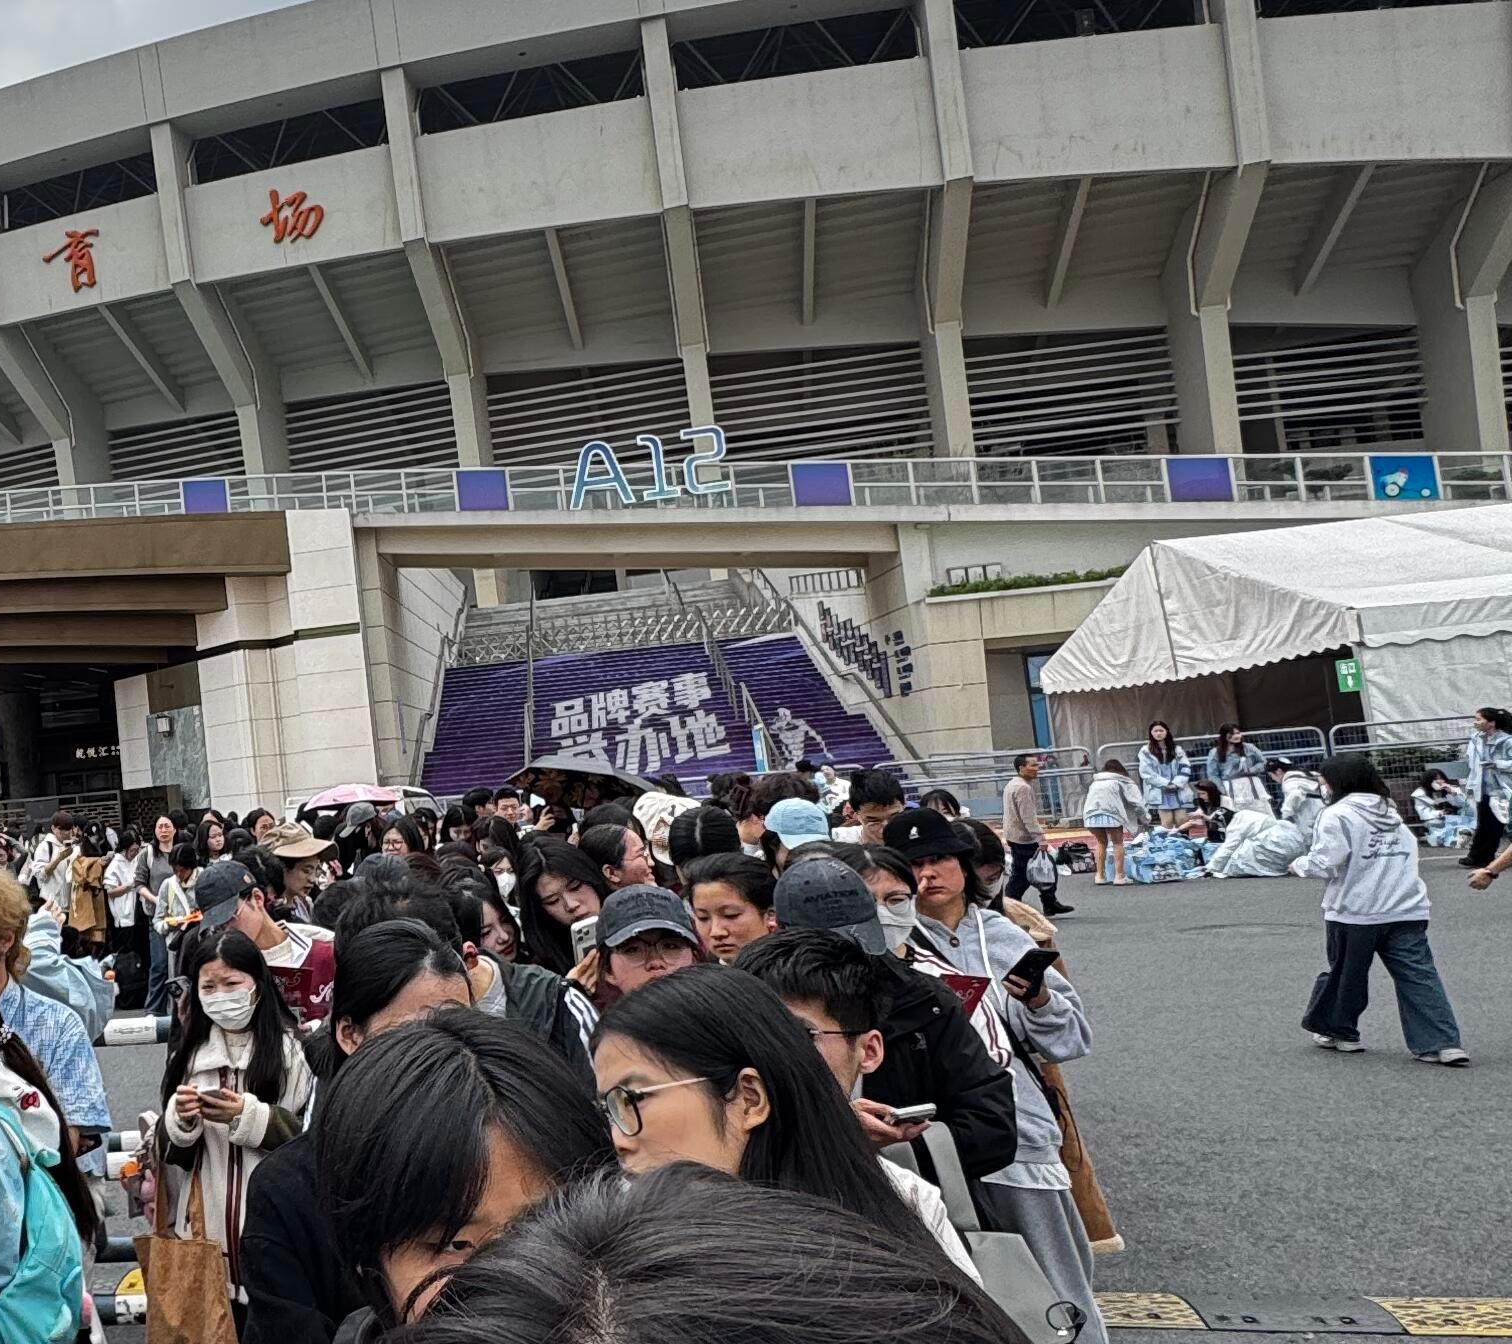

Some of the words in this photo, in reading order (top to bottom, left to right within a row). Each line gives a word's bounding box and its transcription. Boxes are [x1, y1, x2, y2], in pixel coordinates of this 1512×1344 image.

[570, 424, 732, 511] A12
[551, 671, 712, 737] 品牌赛事
